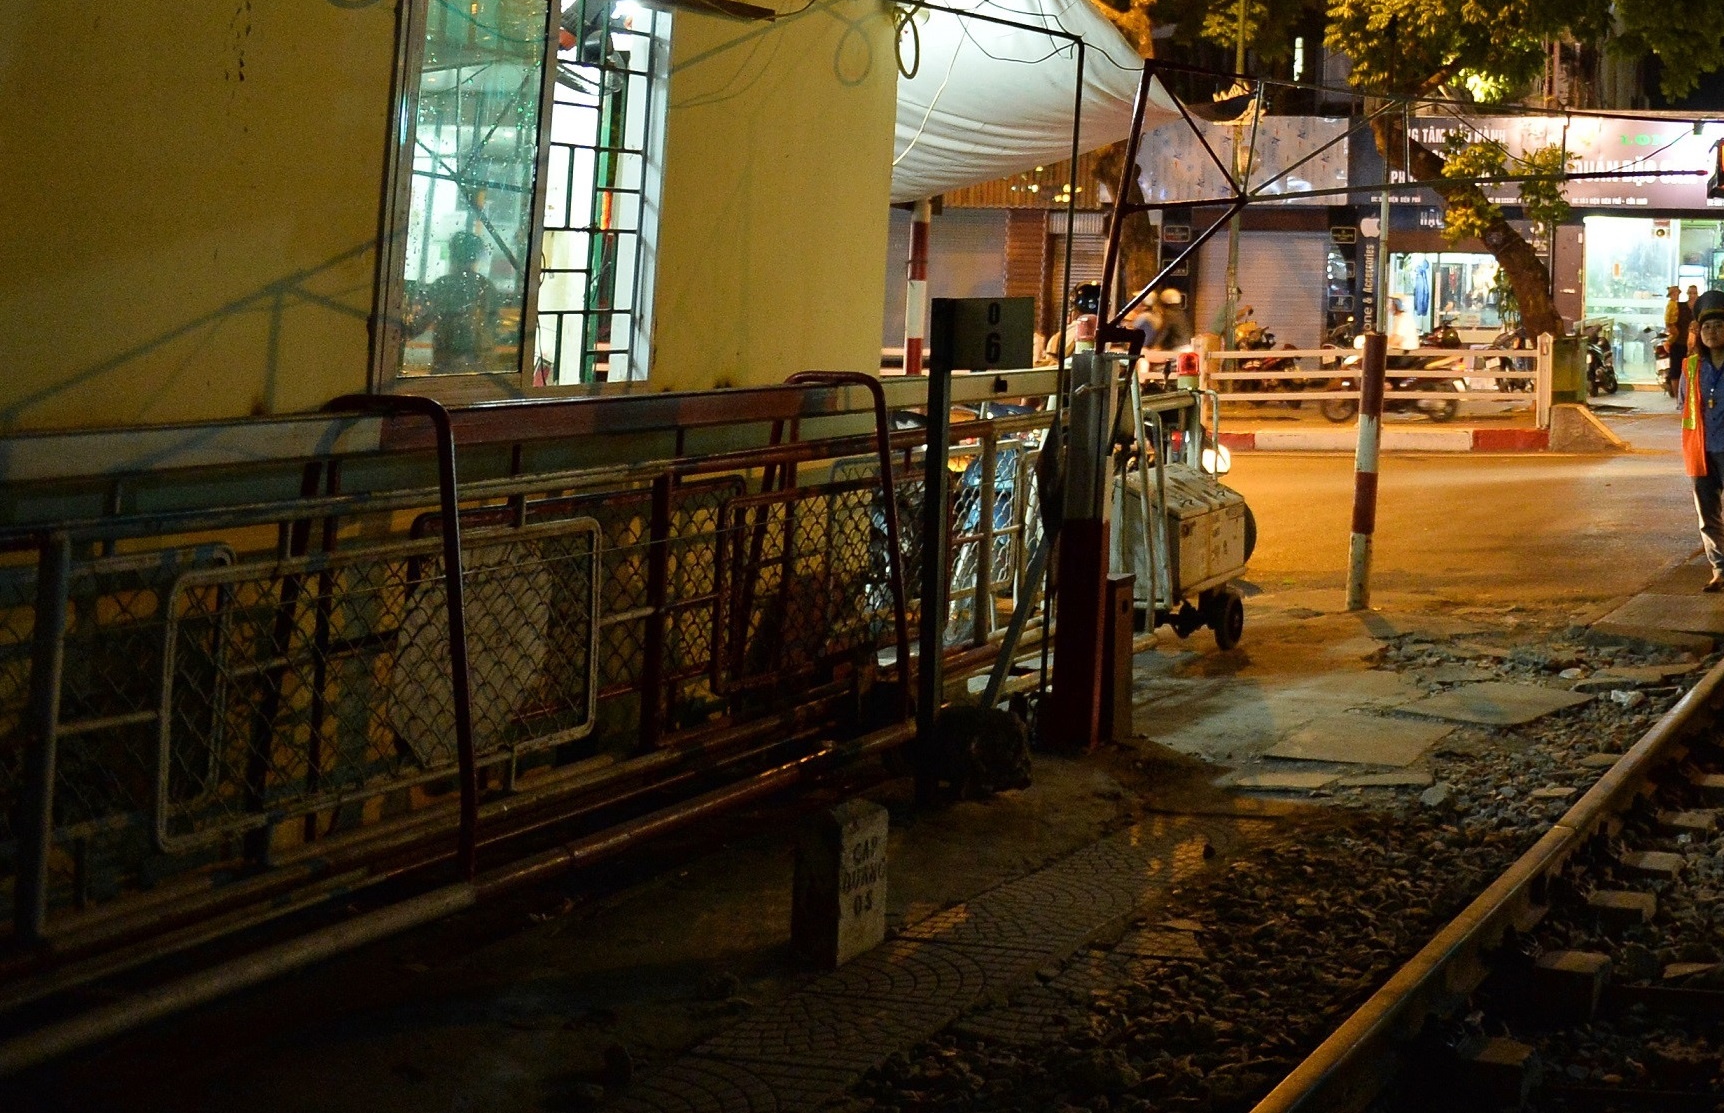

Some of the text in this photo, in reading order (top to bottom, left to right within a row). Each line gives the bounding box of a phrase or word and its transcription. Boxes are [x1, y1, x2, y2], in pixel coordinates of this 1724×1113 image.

[1362, 244, 1375, 294] Accessories
[1362, 296, 1373, 305] &
[984, 332, 1001, 365] 6
